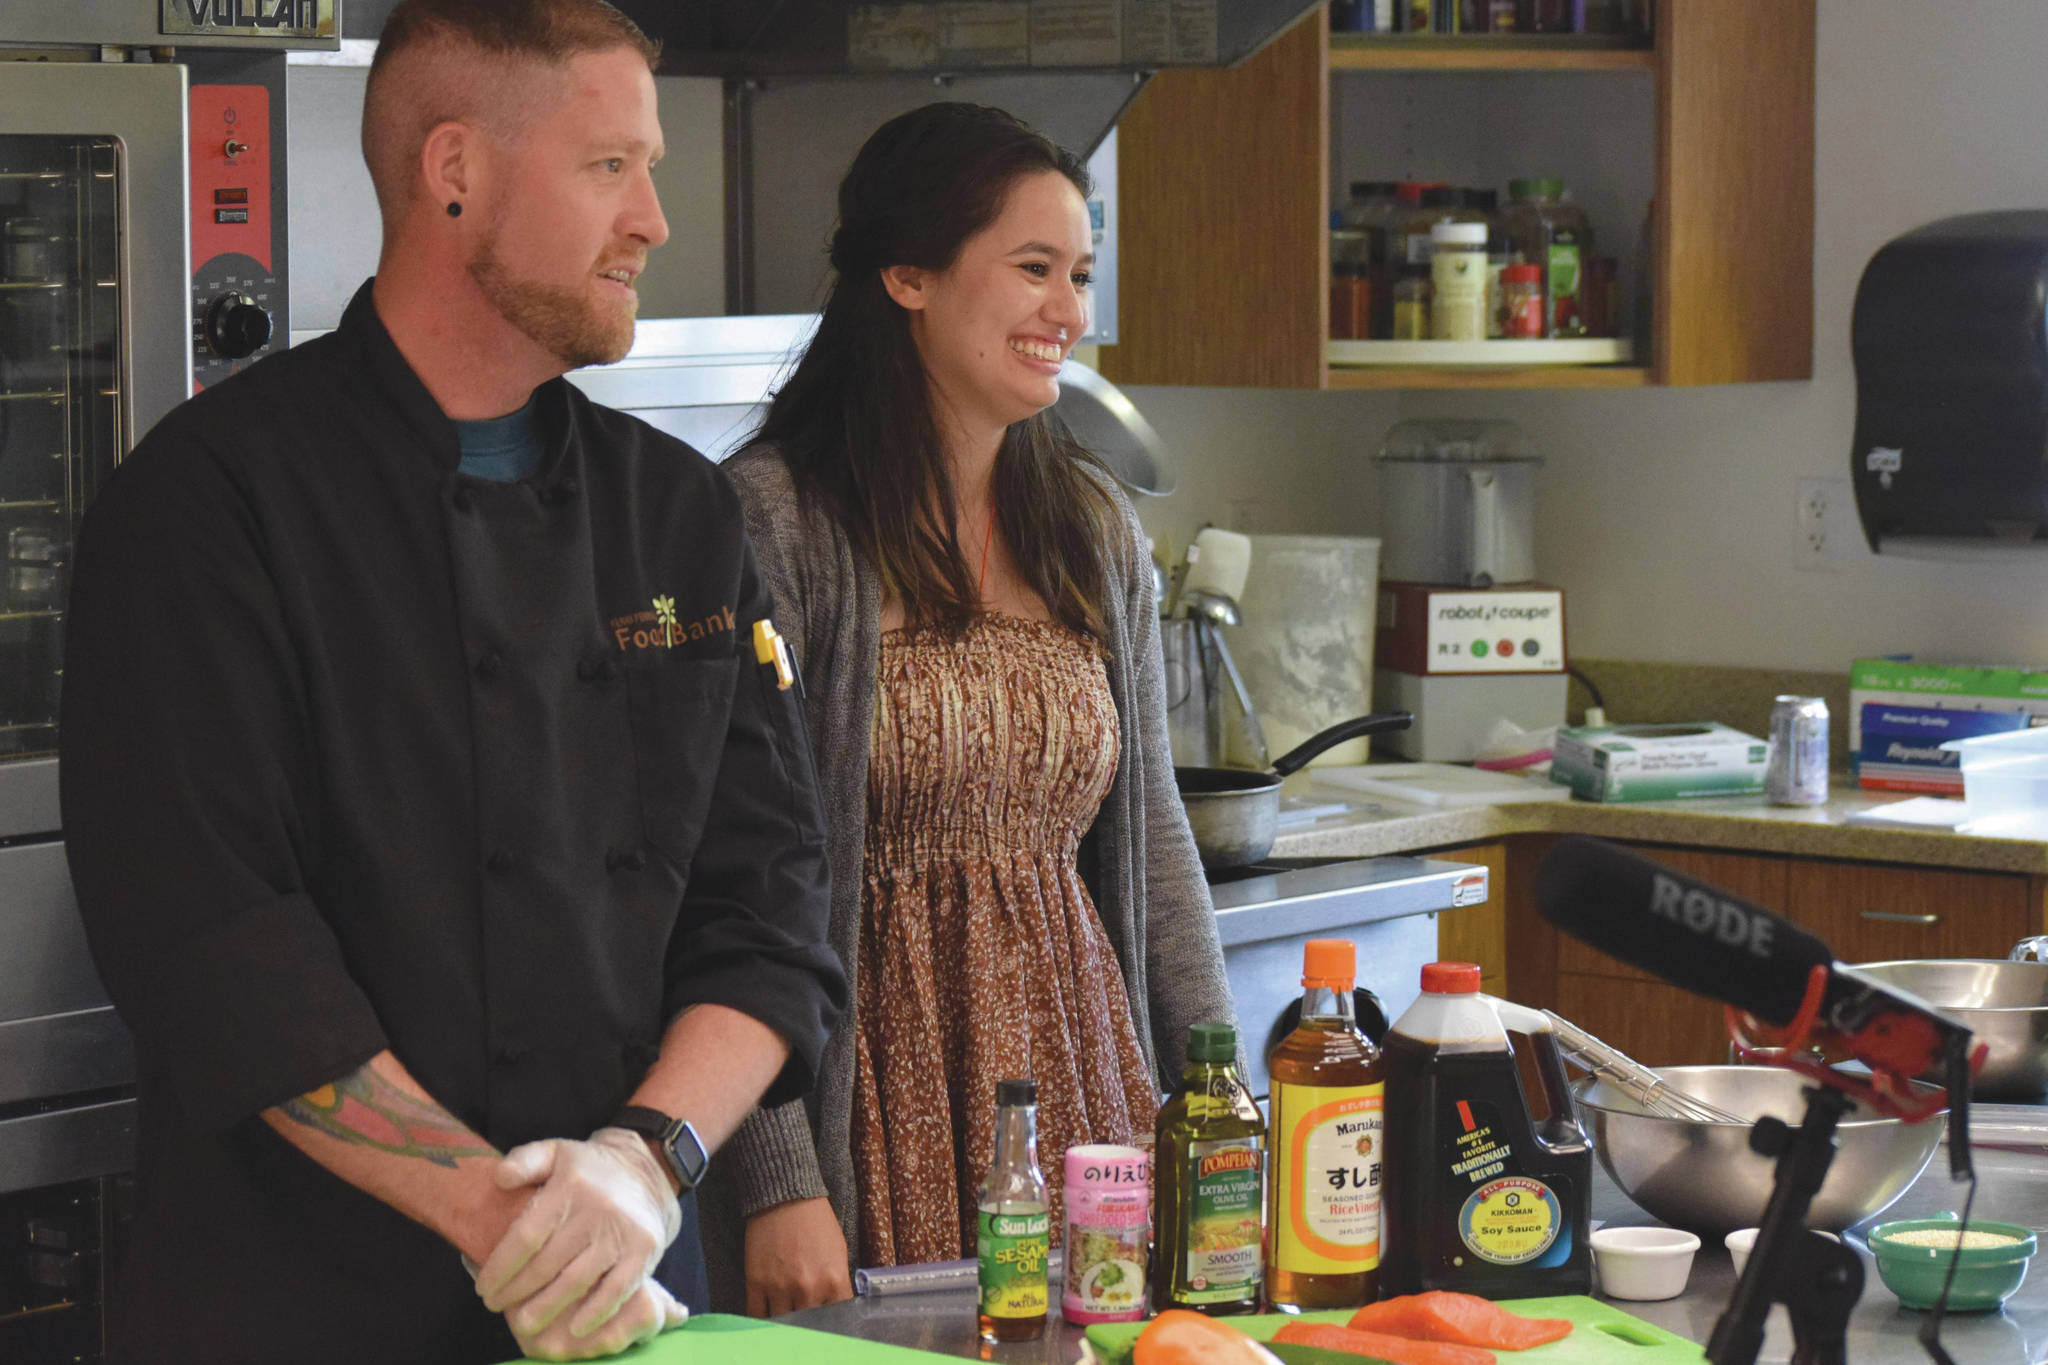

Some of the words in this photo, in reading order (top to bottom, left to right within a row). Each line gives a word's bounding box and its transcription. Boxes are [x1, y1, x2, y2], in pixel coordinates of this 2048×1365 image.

[1439, 604, 1484, 620] robot
[1500, 607, 1550, 620] coupe
[671, 605, 736, 646] Bank
[1452, 643, 1461, 654] 2
[1462, 1140, 1496, 1159] FAVORITE
[1203, 1152, 1258, 1174] POMPEIAN
[1451, 1144, 1511, 1176] TRADITIONALLY
[1469, 1161, 1504, 1183] BREWED
[1199, 1183, 1229, 1196] EXTRA
[1212, 1194, 1235, 1204] OLIVE
[1236, 1192, 1249, 1202] OIL
[1330, 1202, 1354, 1216] Rice
[1491, 1207, 1534, 1217] KIKKOMAN
[999, 1217, 1026, 1235] Sun
[1481, 1226, 1503, 1236] Soy
[1506, 1224, 1542, 1234] Sauce
[994, 1245, 1048, 1265] SESAM
[1207, 1249, 1253, 1265] SMOOTH
[1016, 1259, 1041, 1274] OIL
